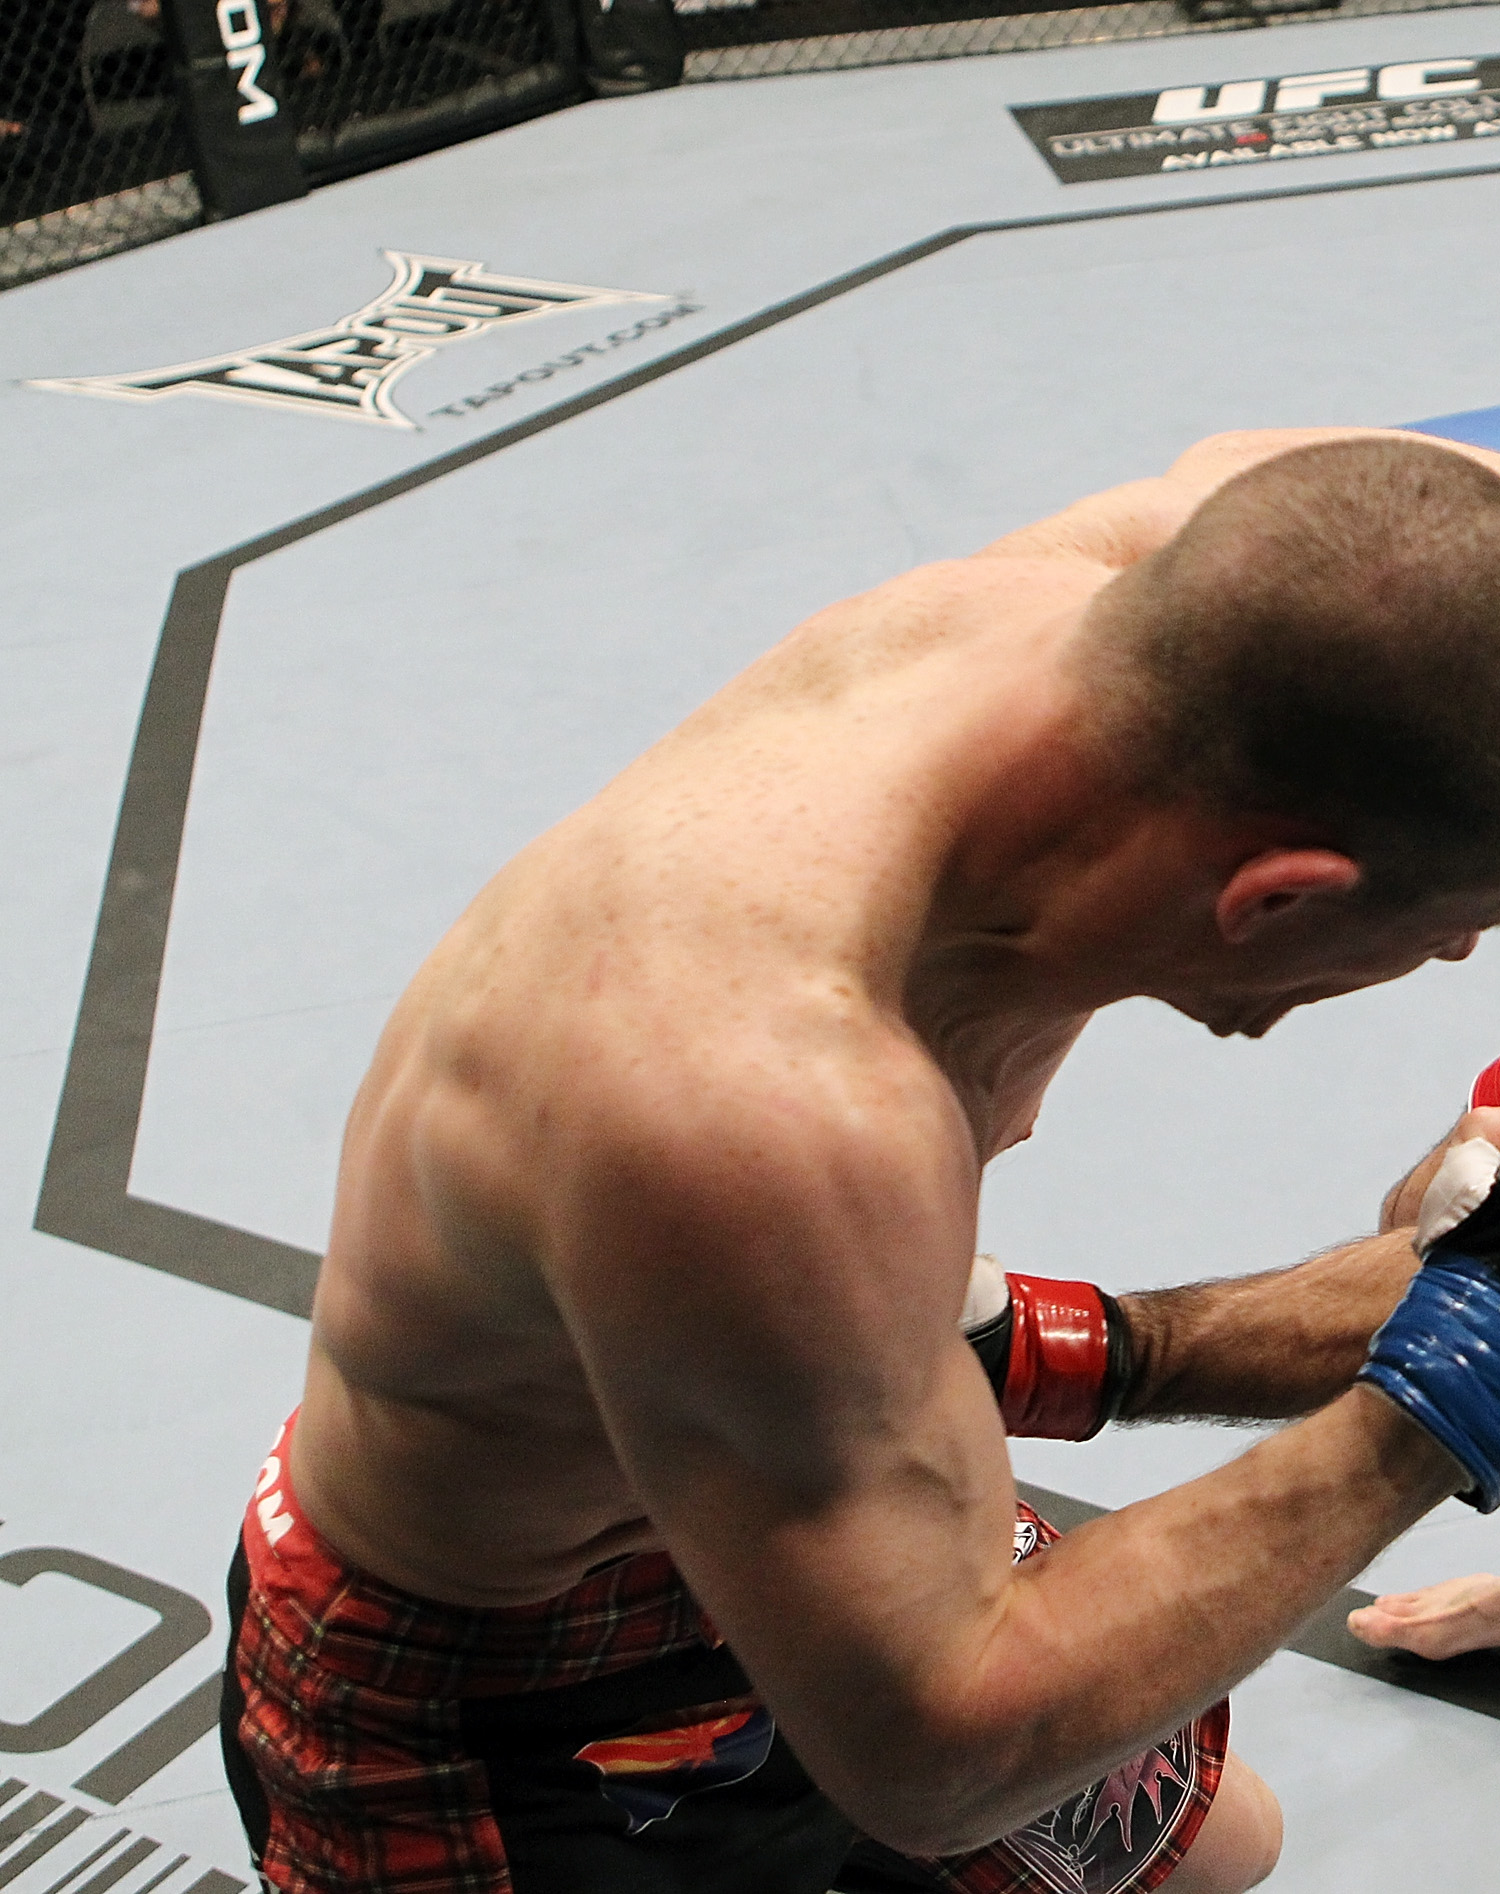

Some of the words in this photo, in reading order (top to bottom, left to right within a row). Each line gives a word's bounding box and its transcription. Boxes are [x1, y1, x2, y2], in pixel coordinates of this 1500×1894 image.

[1152, 58, 1482, 125] UFC
[1051, 120, 1261, 158] ULTIMATE
[1161, 134, 1365, 172] AVAILABLE
[1368, 123, 1458, 149] NOW
[30, 250, 662, 428] TAPOUT
[427, 302, 705, 418] TAPOUT.COM
